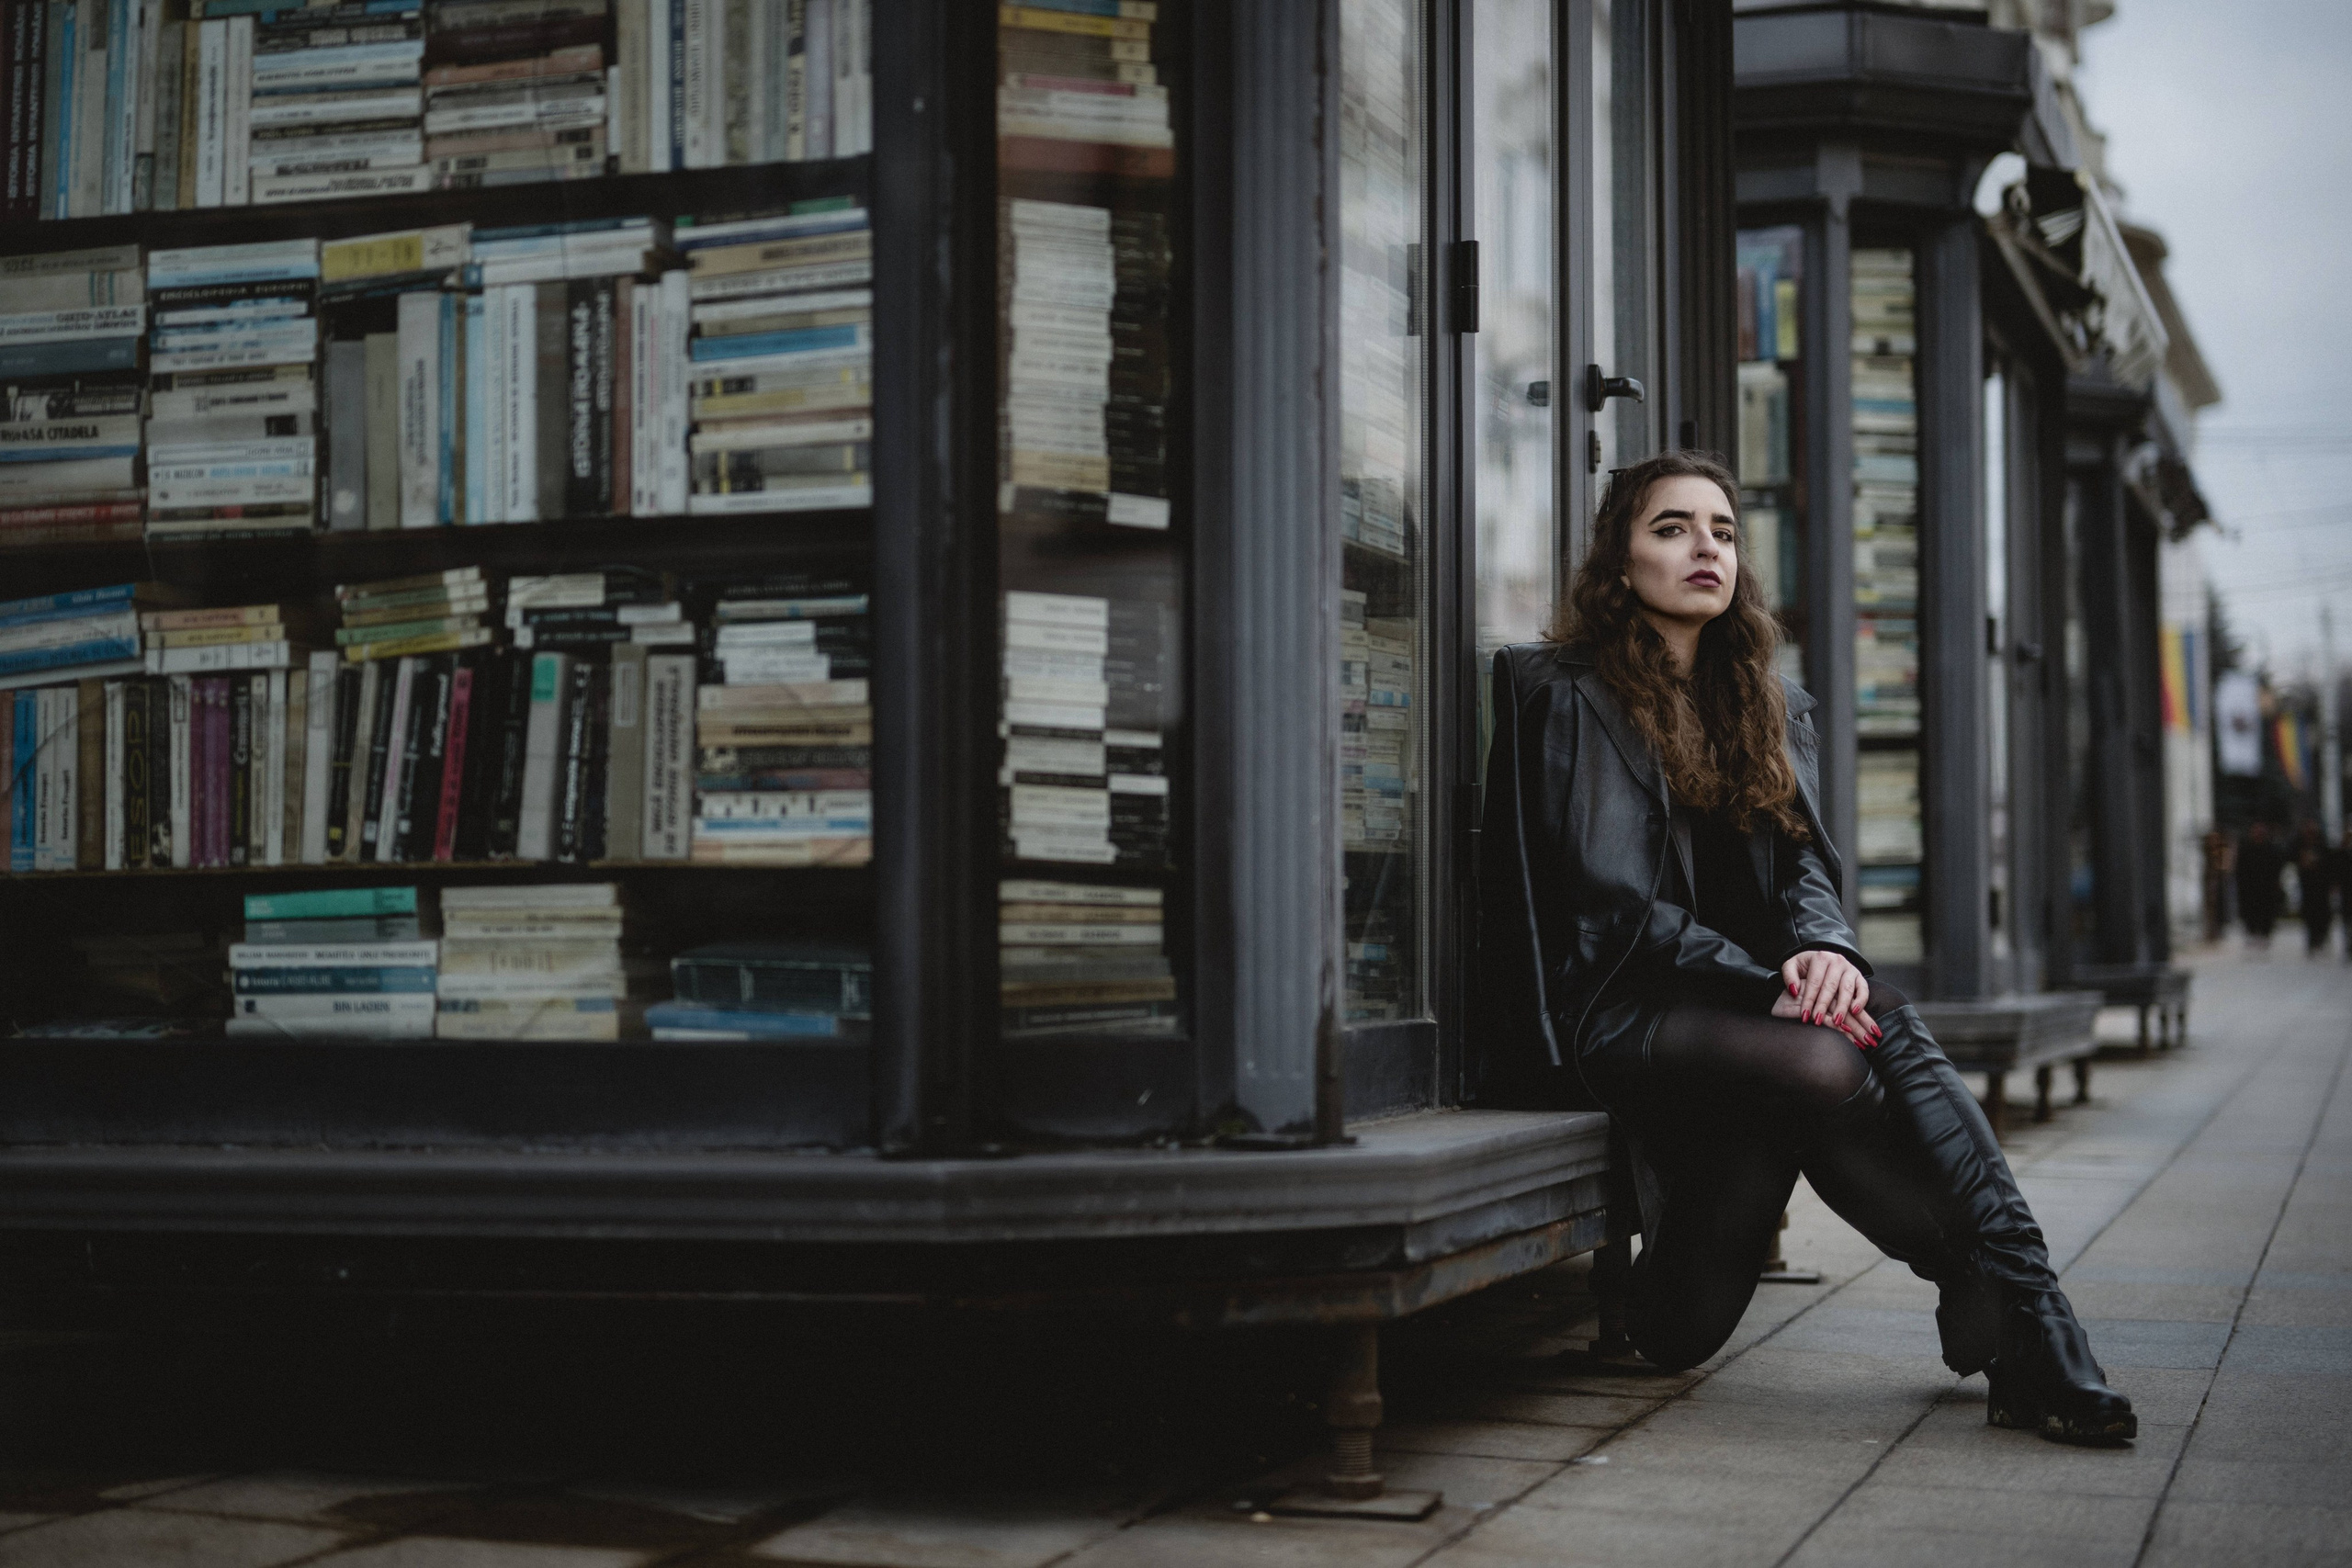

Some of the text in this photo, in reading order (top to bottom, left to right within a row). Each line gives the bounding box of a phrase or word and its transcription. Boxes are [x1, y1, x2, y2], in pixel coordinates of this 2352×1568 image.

[7, 146, 20, 198] ISTORIA
[26, 144, 39, 197] ISTORIA
[127, 709, 147, 861] ESOP
[333, 1000, 390, 1013] BIN LADEN
